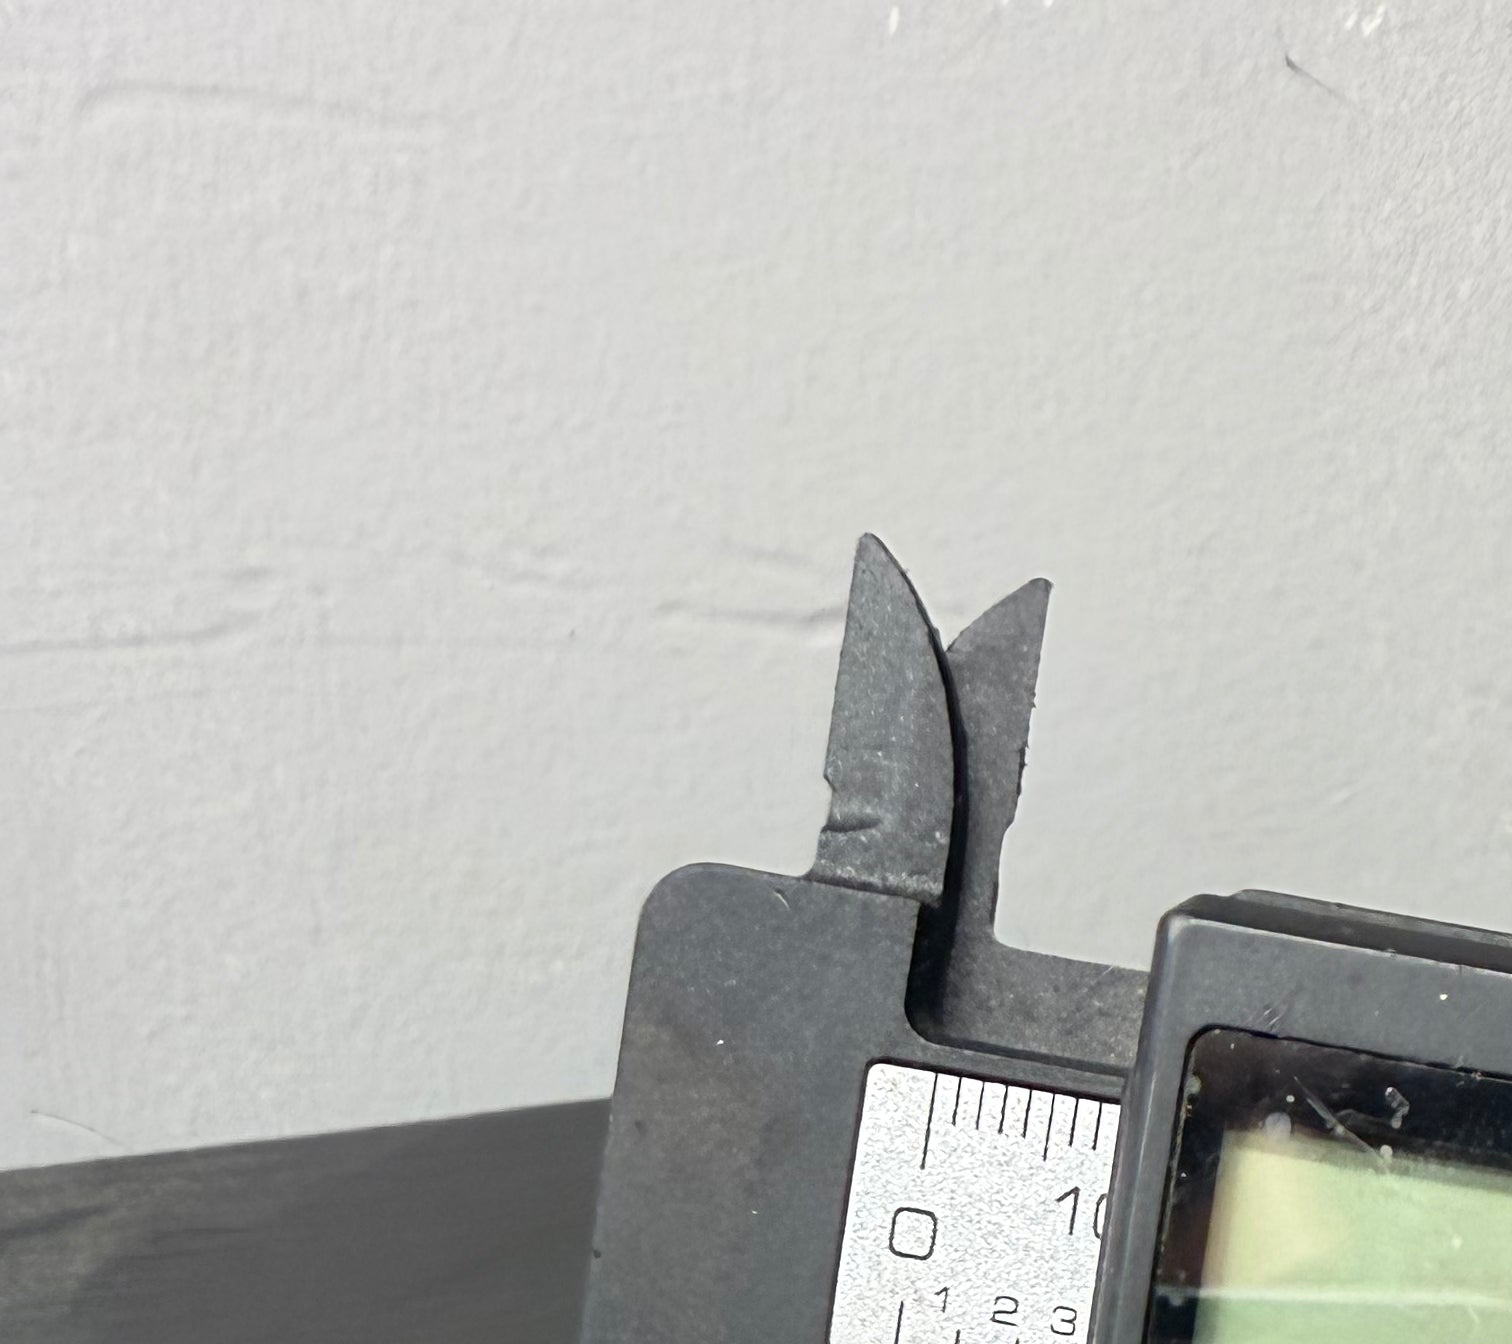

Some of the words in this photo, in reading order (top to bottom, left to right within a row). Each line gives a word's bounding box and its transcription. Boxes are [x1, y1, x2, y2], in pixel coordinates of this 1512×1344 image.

[889, 1206, 937, 1261] 0
[933, 1286, 950, 1313] 1
[990, 1296, 1020, 1327] 2
[1050, 1306, 1078, 1336] 3
